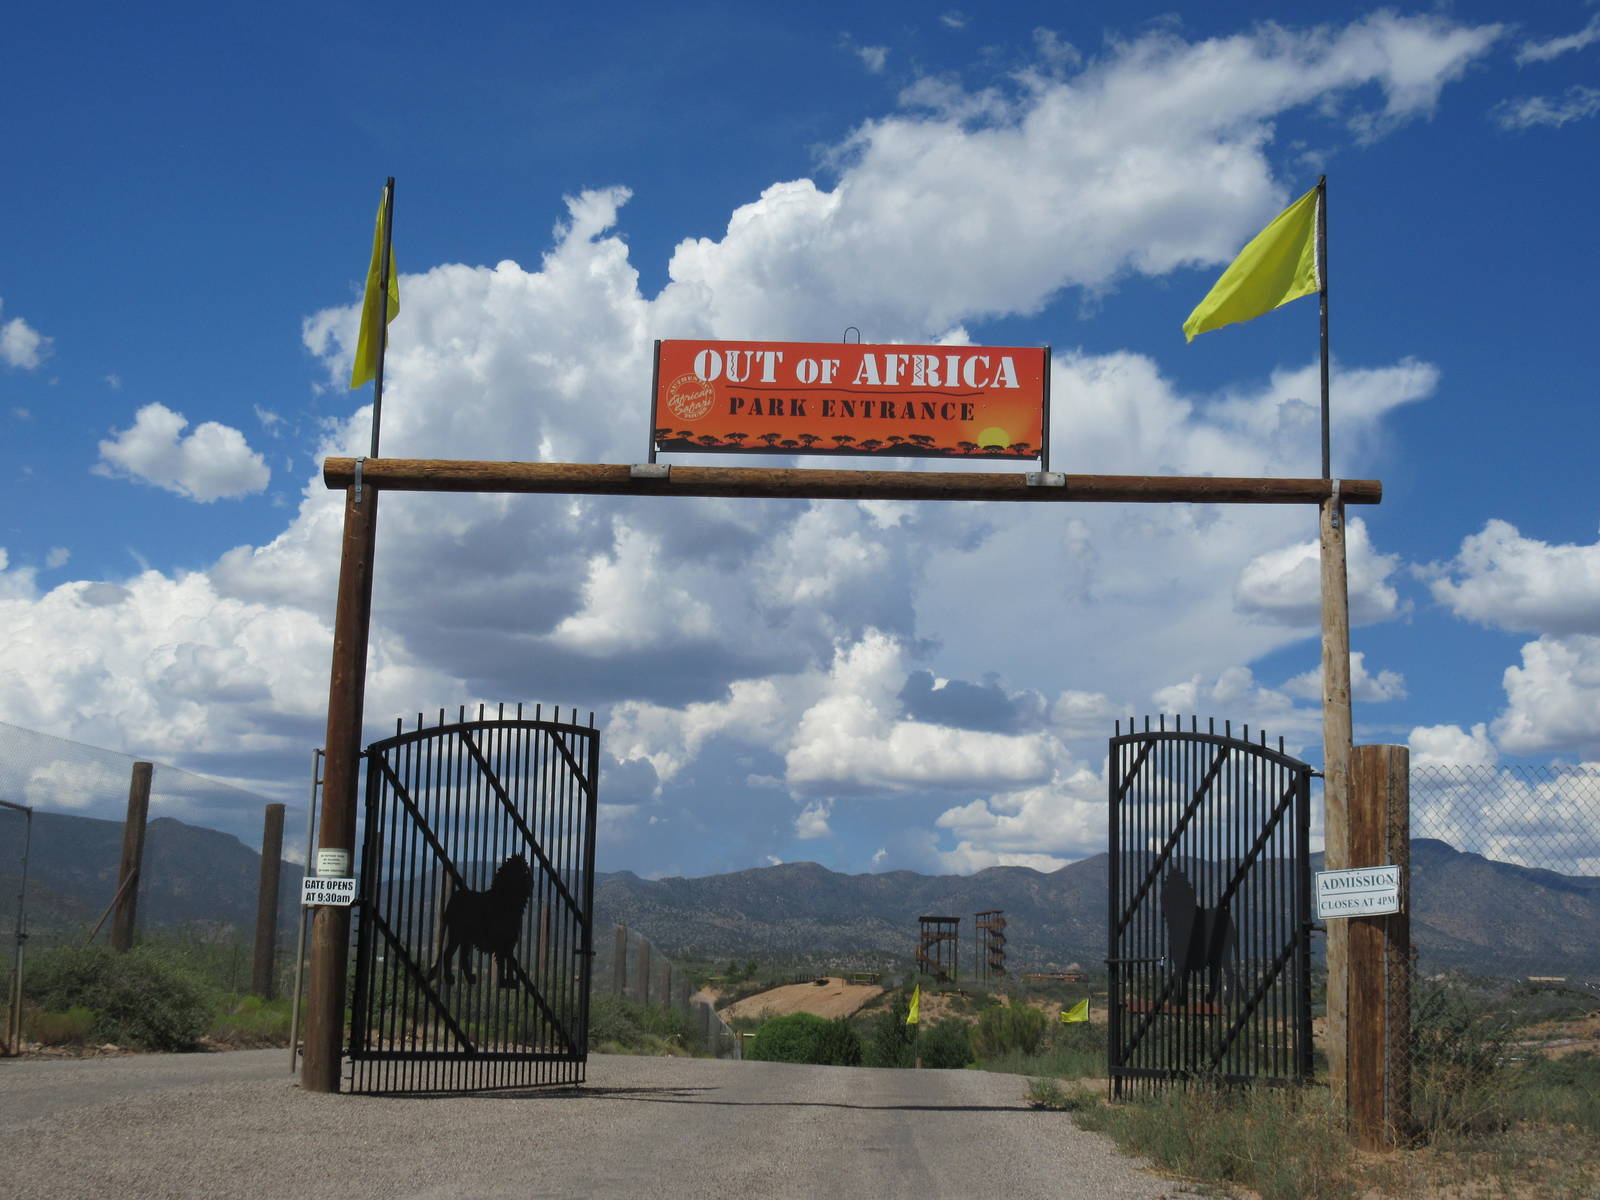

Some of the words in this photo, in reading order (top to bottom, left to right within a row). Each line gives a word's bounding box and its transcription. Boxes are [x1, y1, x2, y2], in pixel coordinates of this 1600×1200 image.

[694, 349, 783, 382] OUT
[796, 358, 840, 384] OF
[852, 353, 1020, 389] AFRICA
[729, 397, 807, 417] PARK
[821, 400, 975, 421] ENTRANCE
[305, 880, 325, 890] GATE
[326, 880, 354, 891] OPENS
[1321, 873, 1395, 890] ADMISSION
[305, 892, 316, 902] AT
[317, 892, 351, 903] 9:30am
[1321, 898, 1360, 910] CLOSES
[1361, 897, 1374, 907] AT
[1376, 896, 1395, 905] 4PM
